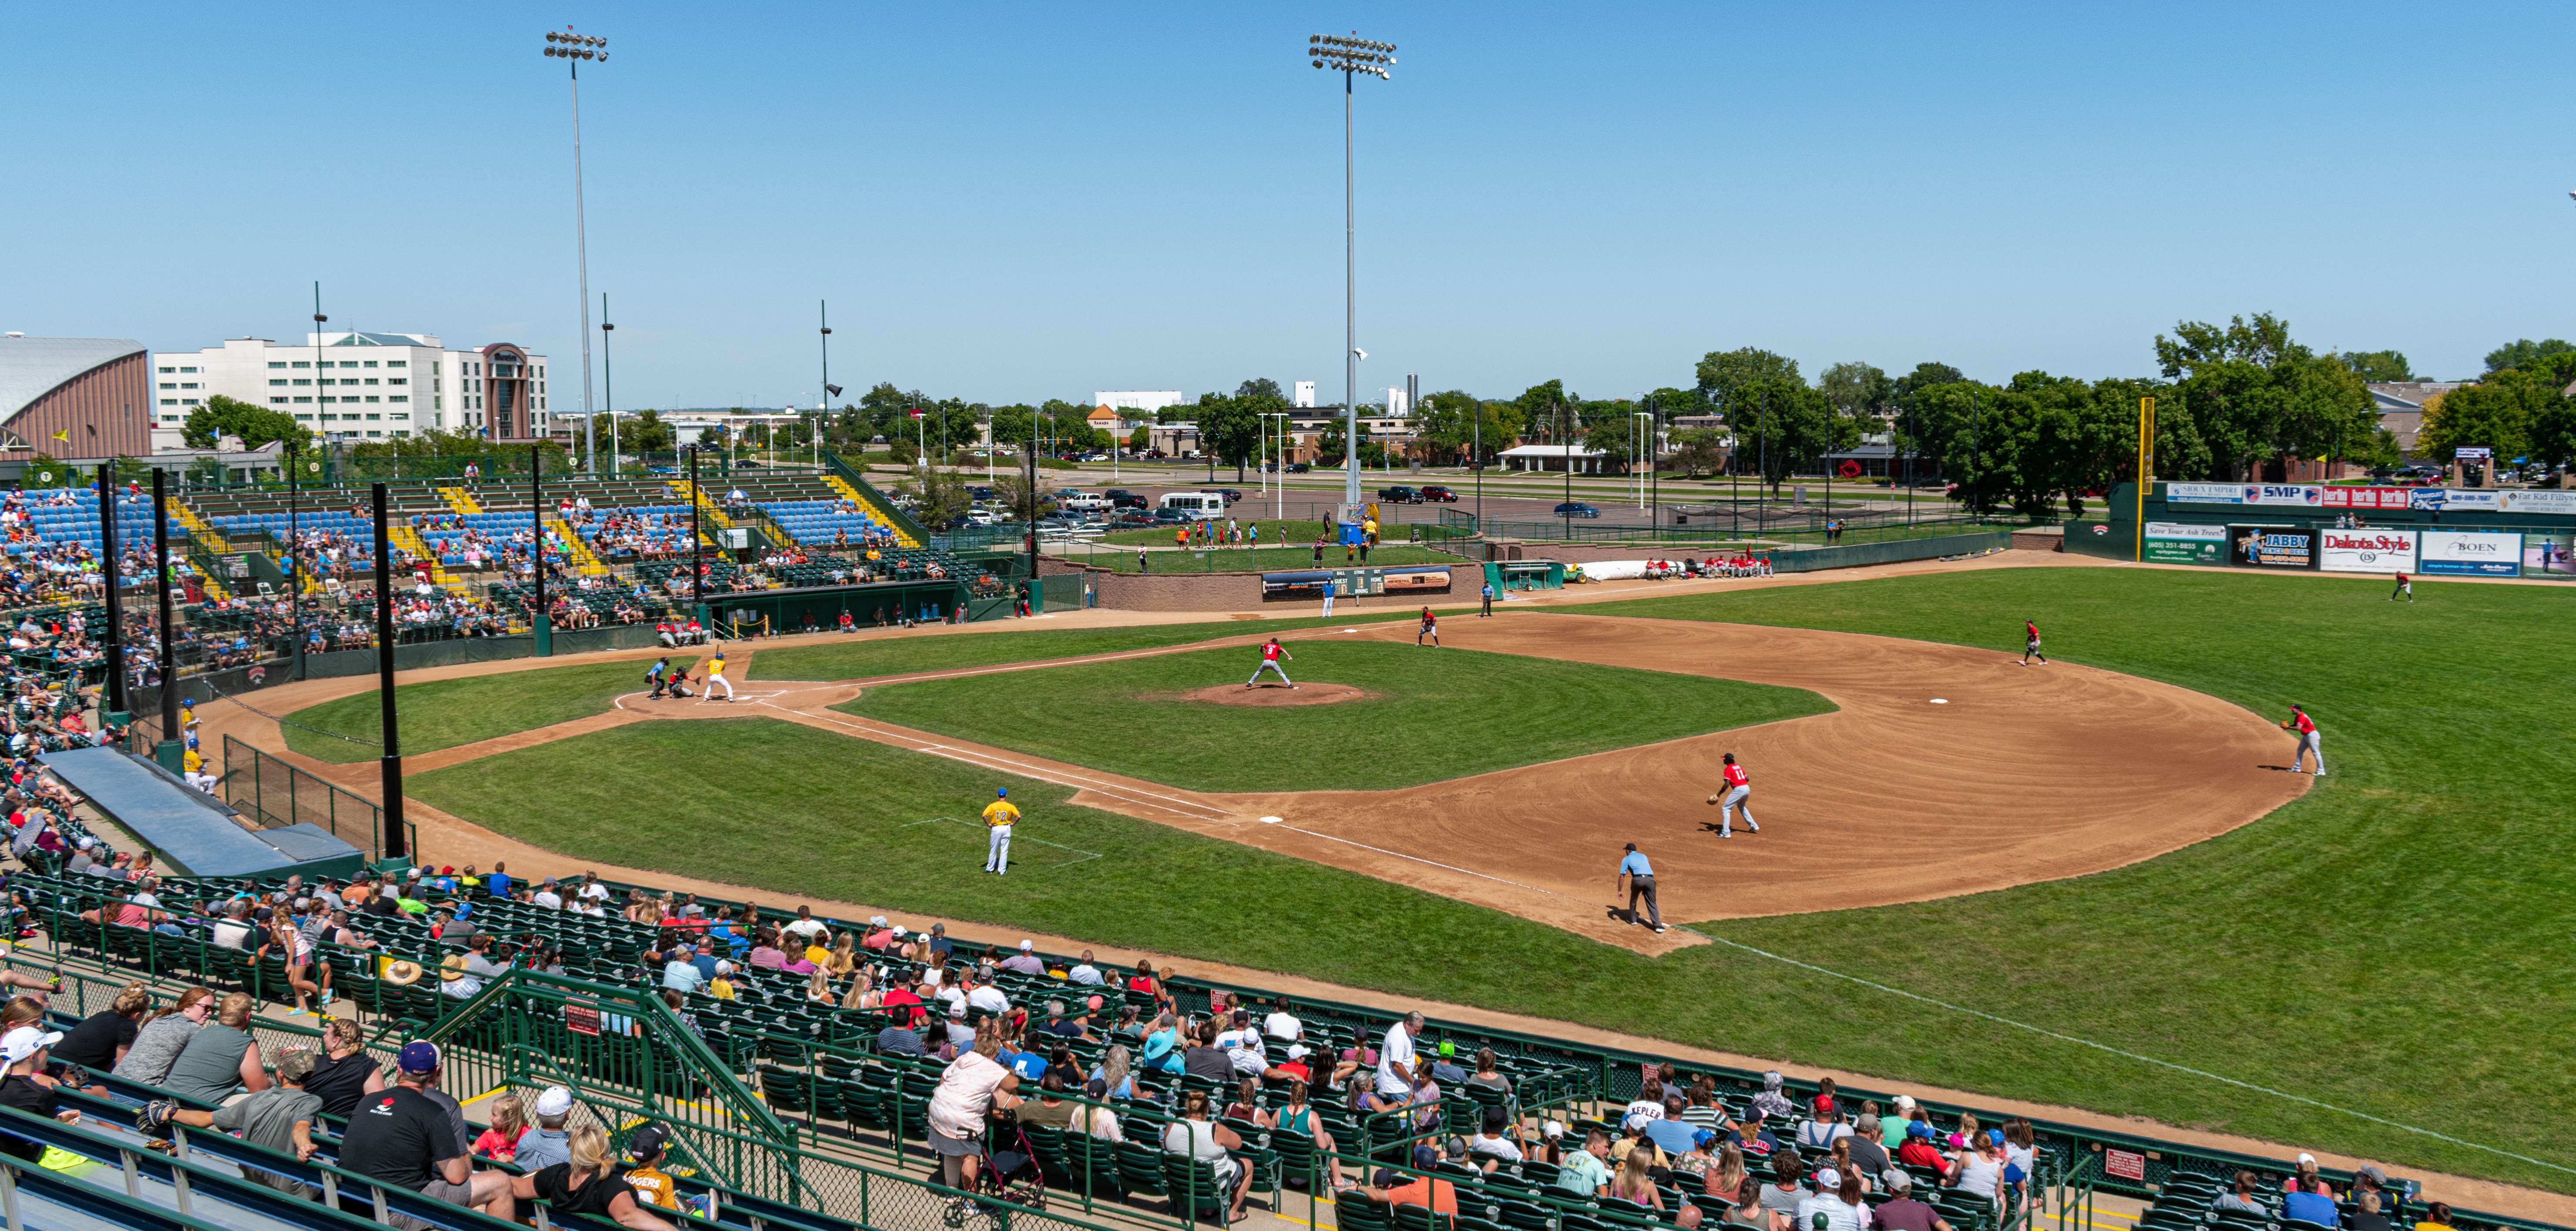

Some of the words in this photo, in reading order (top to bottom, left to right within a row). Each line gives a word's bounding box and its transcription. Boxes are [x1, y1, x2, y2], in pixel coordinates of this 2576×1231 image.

[2264, 487, 2300, 497] SMP
[2324, 489, 2347, 501] berlin
[2352, 489, 2376, 502] berlin
[2381, 490, 2406, 503] berlin
[2266, 535, 2309, 547] JABBY
[2324, 535, 2374, 549] Dakota
[2375, 535, 2411, 555] Style
[1735, 769, 1745, 780] 11
[995, 811, 1008, 821] 12
[1632, 1107, 1661, 1120] KEPLER
